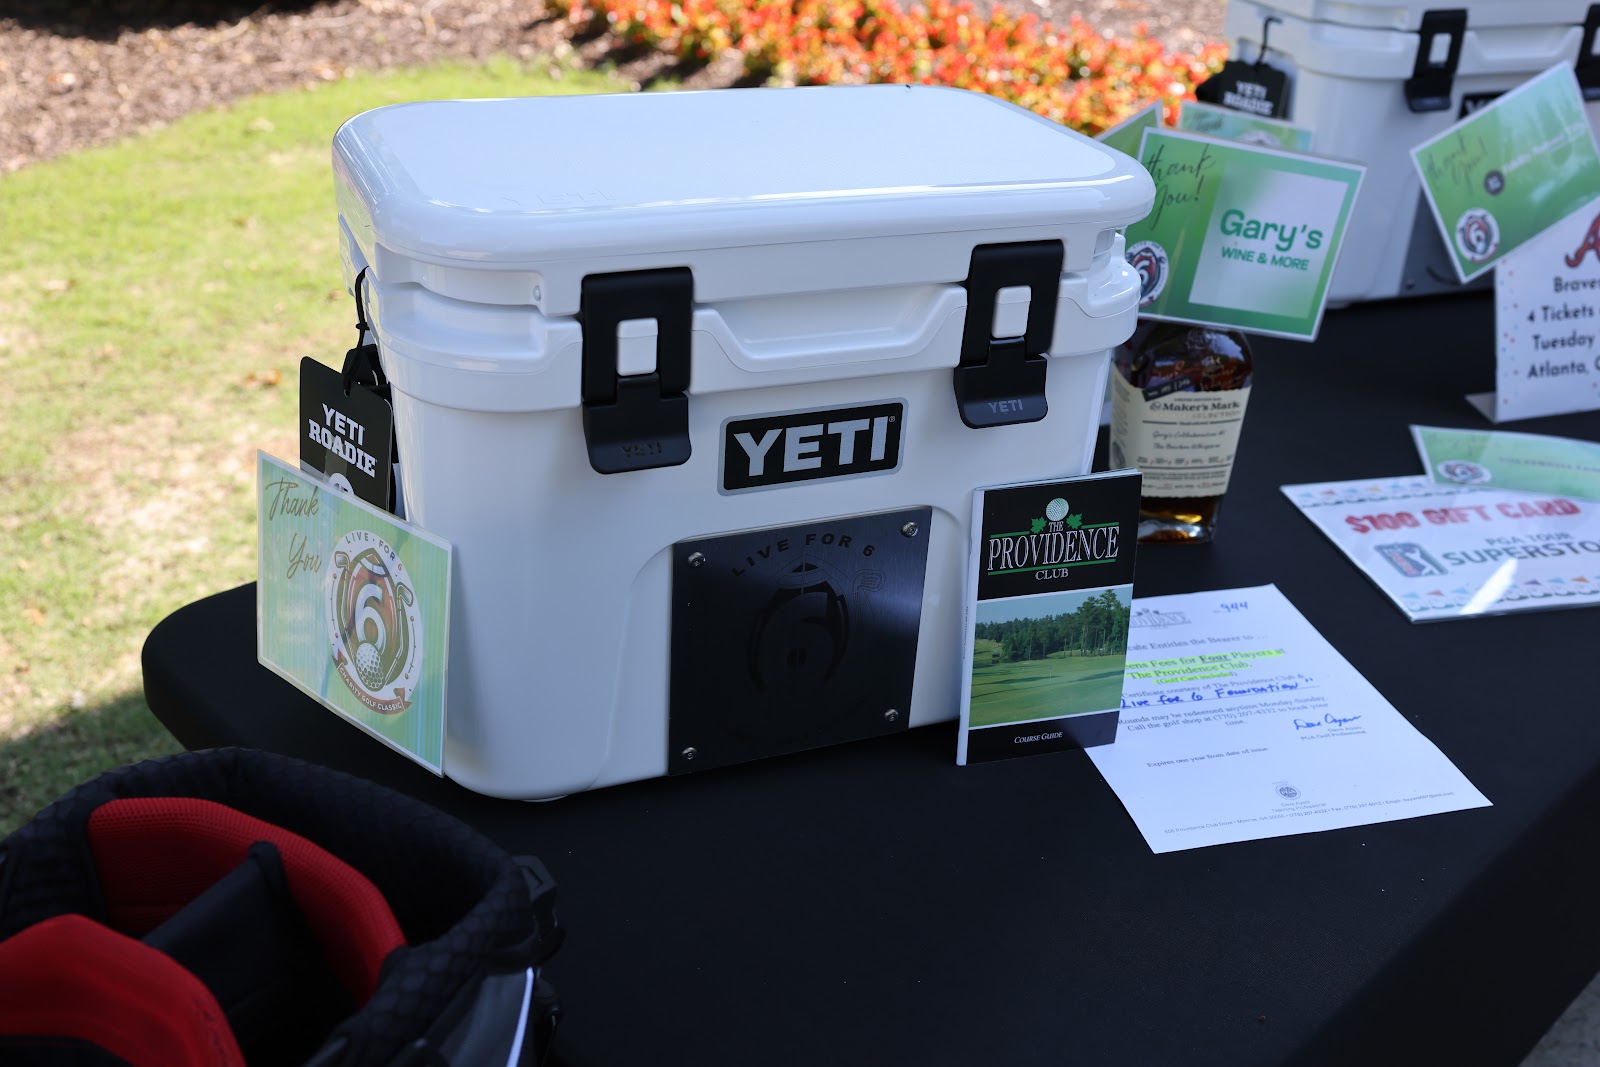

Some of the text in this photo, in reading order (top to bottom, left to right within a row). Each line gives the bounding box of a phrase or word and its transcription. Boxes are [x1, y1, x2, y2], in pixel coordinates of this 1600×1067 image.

[1219, 208, 1324, 252] Gary's
[1221, 246, 1310, 271] WINE & MORE
[1527, 303, 1595, 323] 4 Tickets
[1532, 329, 1596, 350] Tuesday
[988, 399, 1024, 414] YETI
[1162, 401, 1241, 412] Maker's Mark
[322, 403, 366, 447] YETI
[308, 418, 378, 479] ROADIE
[622, 441, 663, 458] YETI
[733, 416, 890, 477] YETI
[265, 477, 320, 522] Thank
[1049, 520, 1065, 533] THE
[1345, 498, 1582, 535] $100 GIFT CARD
[346, 531, 369, 544] LIVE
[379, 539, 396, 561] FOR
[987, 526, 1120, 571] PROVIDENCE
[1485, 531, 1574, 547] PGA TOUR
[286, 531, 323, 580] You
[731, 532, 876, 577] LIVE FOR 6
[1035, 567, 1069, 580] CLUB
[1150, 639, 1188, 651] Entitles
[1190, 638, 1206, 646] the
[1209, 635, 1241, 644] Bearer
[1150, 659, 1178, 668] Fees
[1179, 657, 1197, 665] for
[1200, 653, 1232, 664] Four
[1231, 650, 1274, 661] Players
[1130, 671, 1152, 680] The
[1154, 665, 1215, 678] Providence
[339, 667, 402, 711] CHARITY GOLF CLASSIC
[1166, 684, 1201, 695] courtesy
[1213, 680, 1228, 688] The
[1230, 677, 1274, 688] Providence
[1275, 675, 1294, 683] Club
[1121, 698, 1150, 709] Live
[1191, 693, 1204, 701] 6
[1127, 724, 1146, 732] Call
[1147, 722, 1162, 730] the
[1163, 719, 1181, 729] golf
[1181, 717, 1202, 726] shop
[1213, 713, 1237, 722] (770)
[1288, 704, 1310, 712] book
[1311, 702, 1328, 710] your
[1151, 714, 1169, 722] may
[1183, 707, 1224, 718] redeemed
[1225, 704, 1257, 714] anytime
[1331, 729, 1367, 737] Professional
[1146, 760, 1176, 768] Expires
[1175, 824, 1206, 833] Providence
